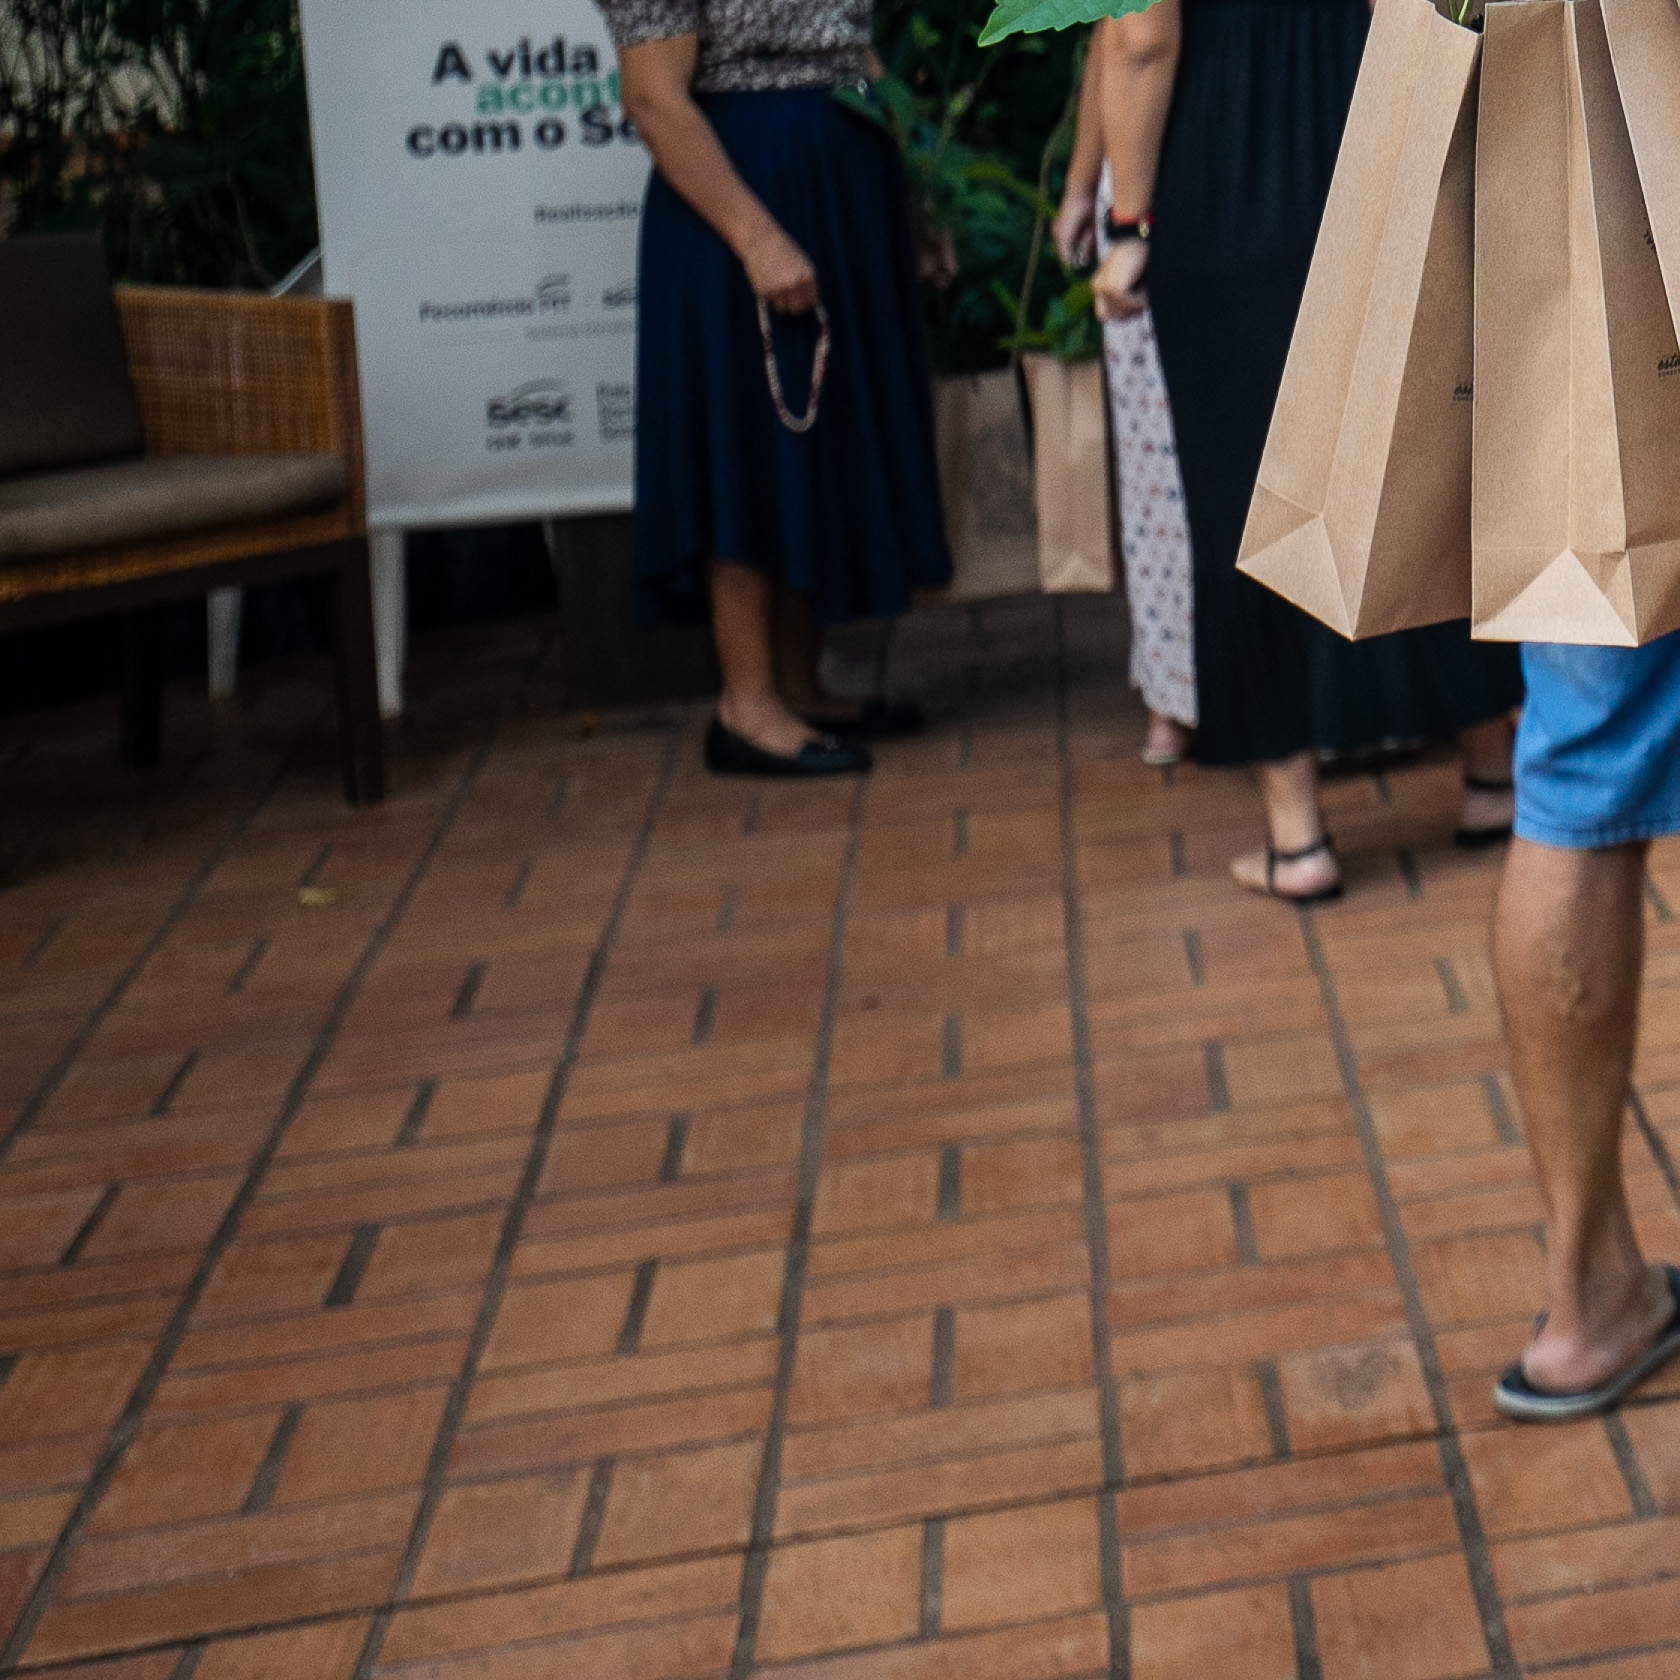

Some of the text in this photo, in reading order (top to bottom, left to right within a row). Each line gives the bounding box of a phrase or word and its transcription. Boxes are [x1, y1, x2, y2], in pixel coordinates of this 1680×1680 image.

[431, 33, 598, 86] A vida
[406, 119, 521, 159] com
[534, 116, 566, 150] o
